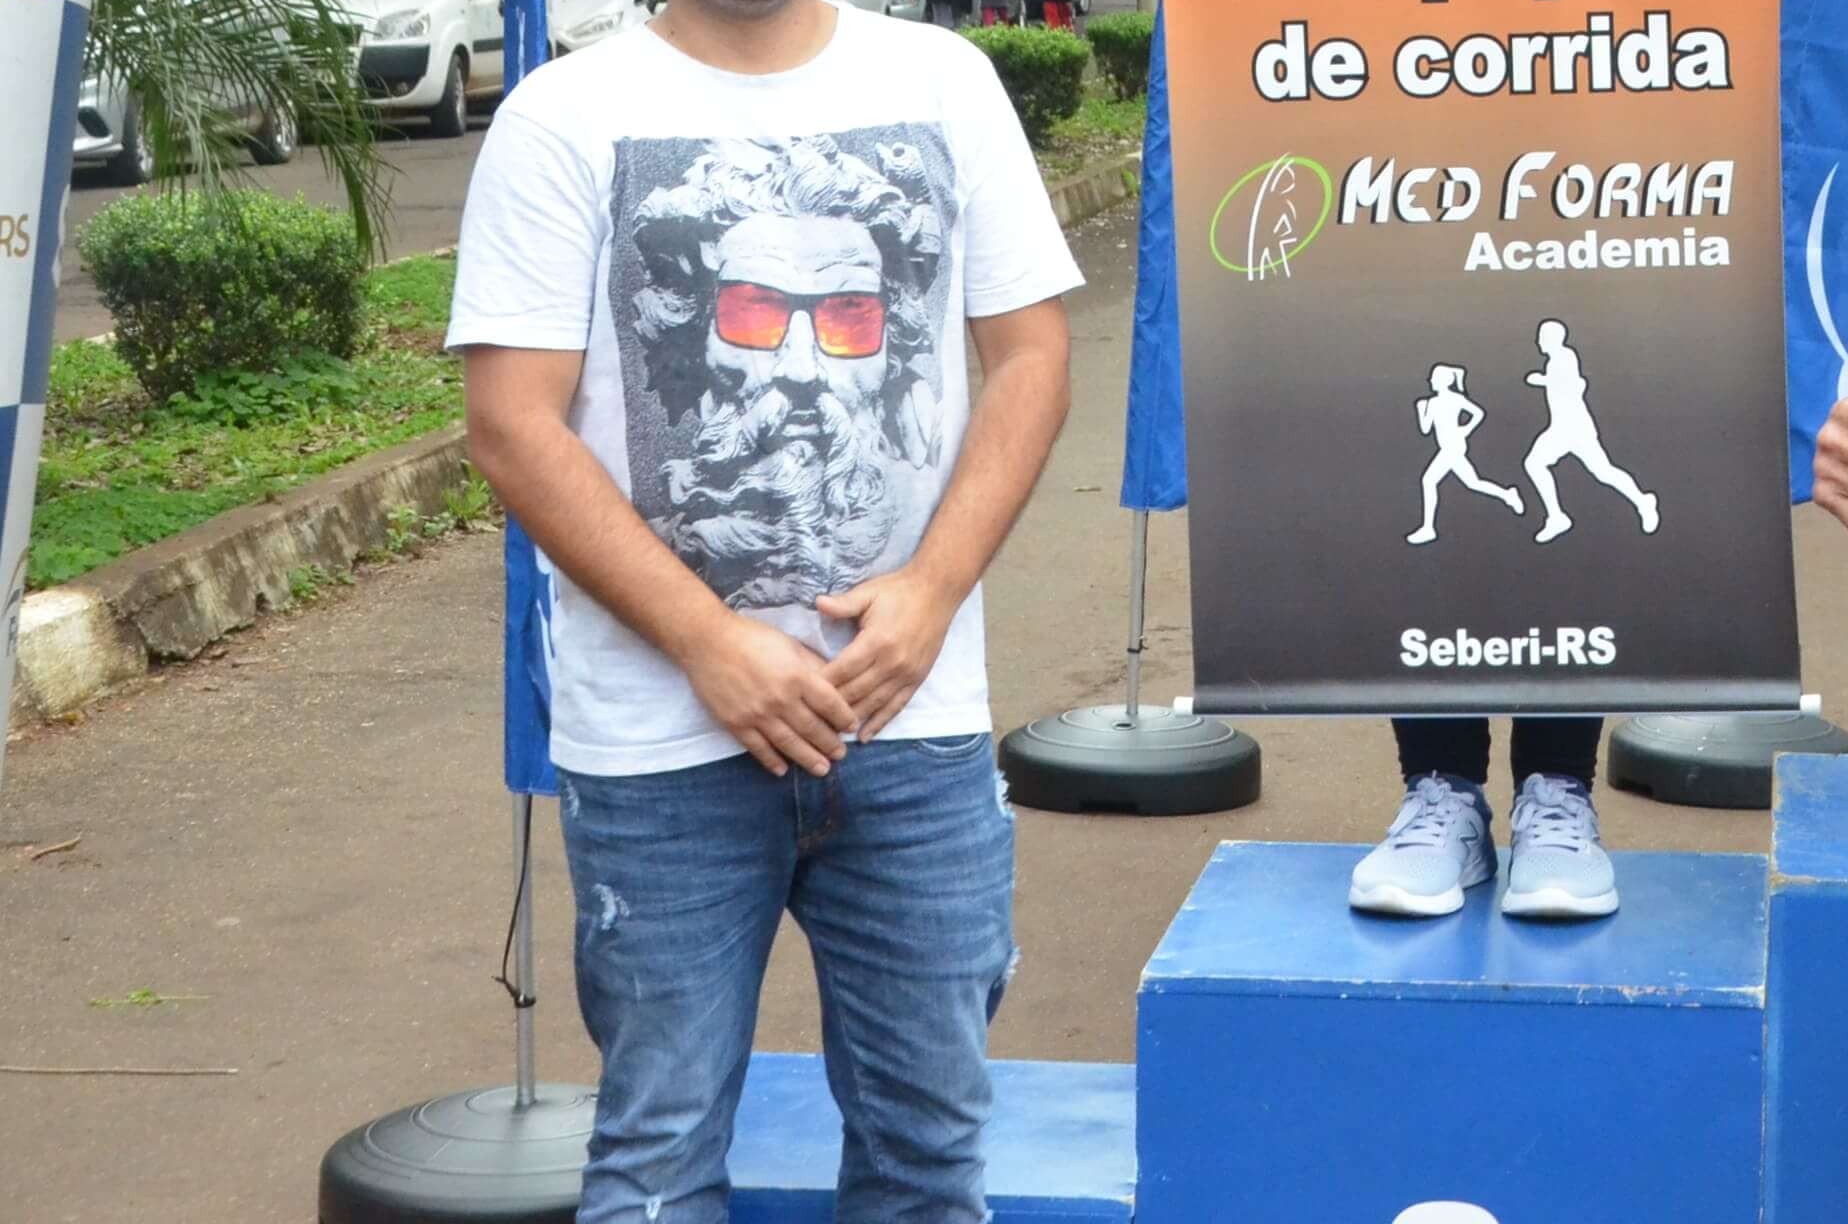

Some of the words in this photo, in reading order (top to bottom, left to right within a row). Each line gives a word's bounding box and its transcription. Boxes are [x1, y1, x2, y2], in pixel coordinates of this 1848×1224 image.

[1252, 20, 1369, 102] de
[1393, 9, 1734, 97] corrida
[1463, 227, 1731, 271] Academia
[1399, 626, 1616, 667] Seberi-RS
